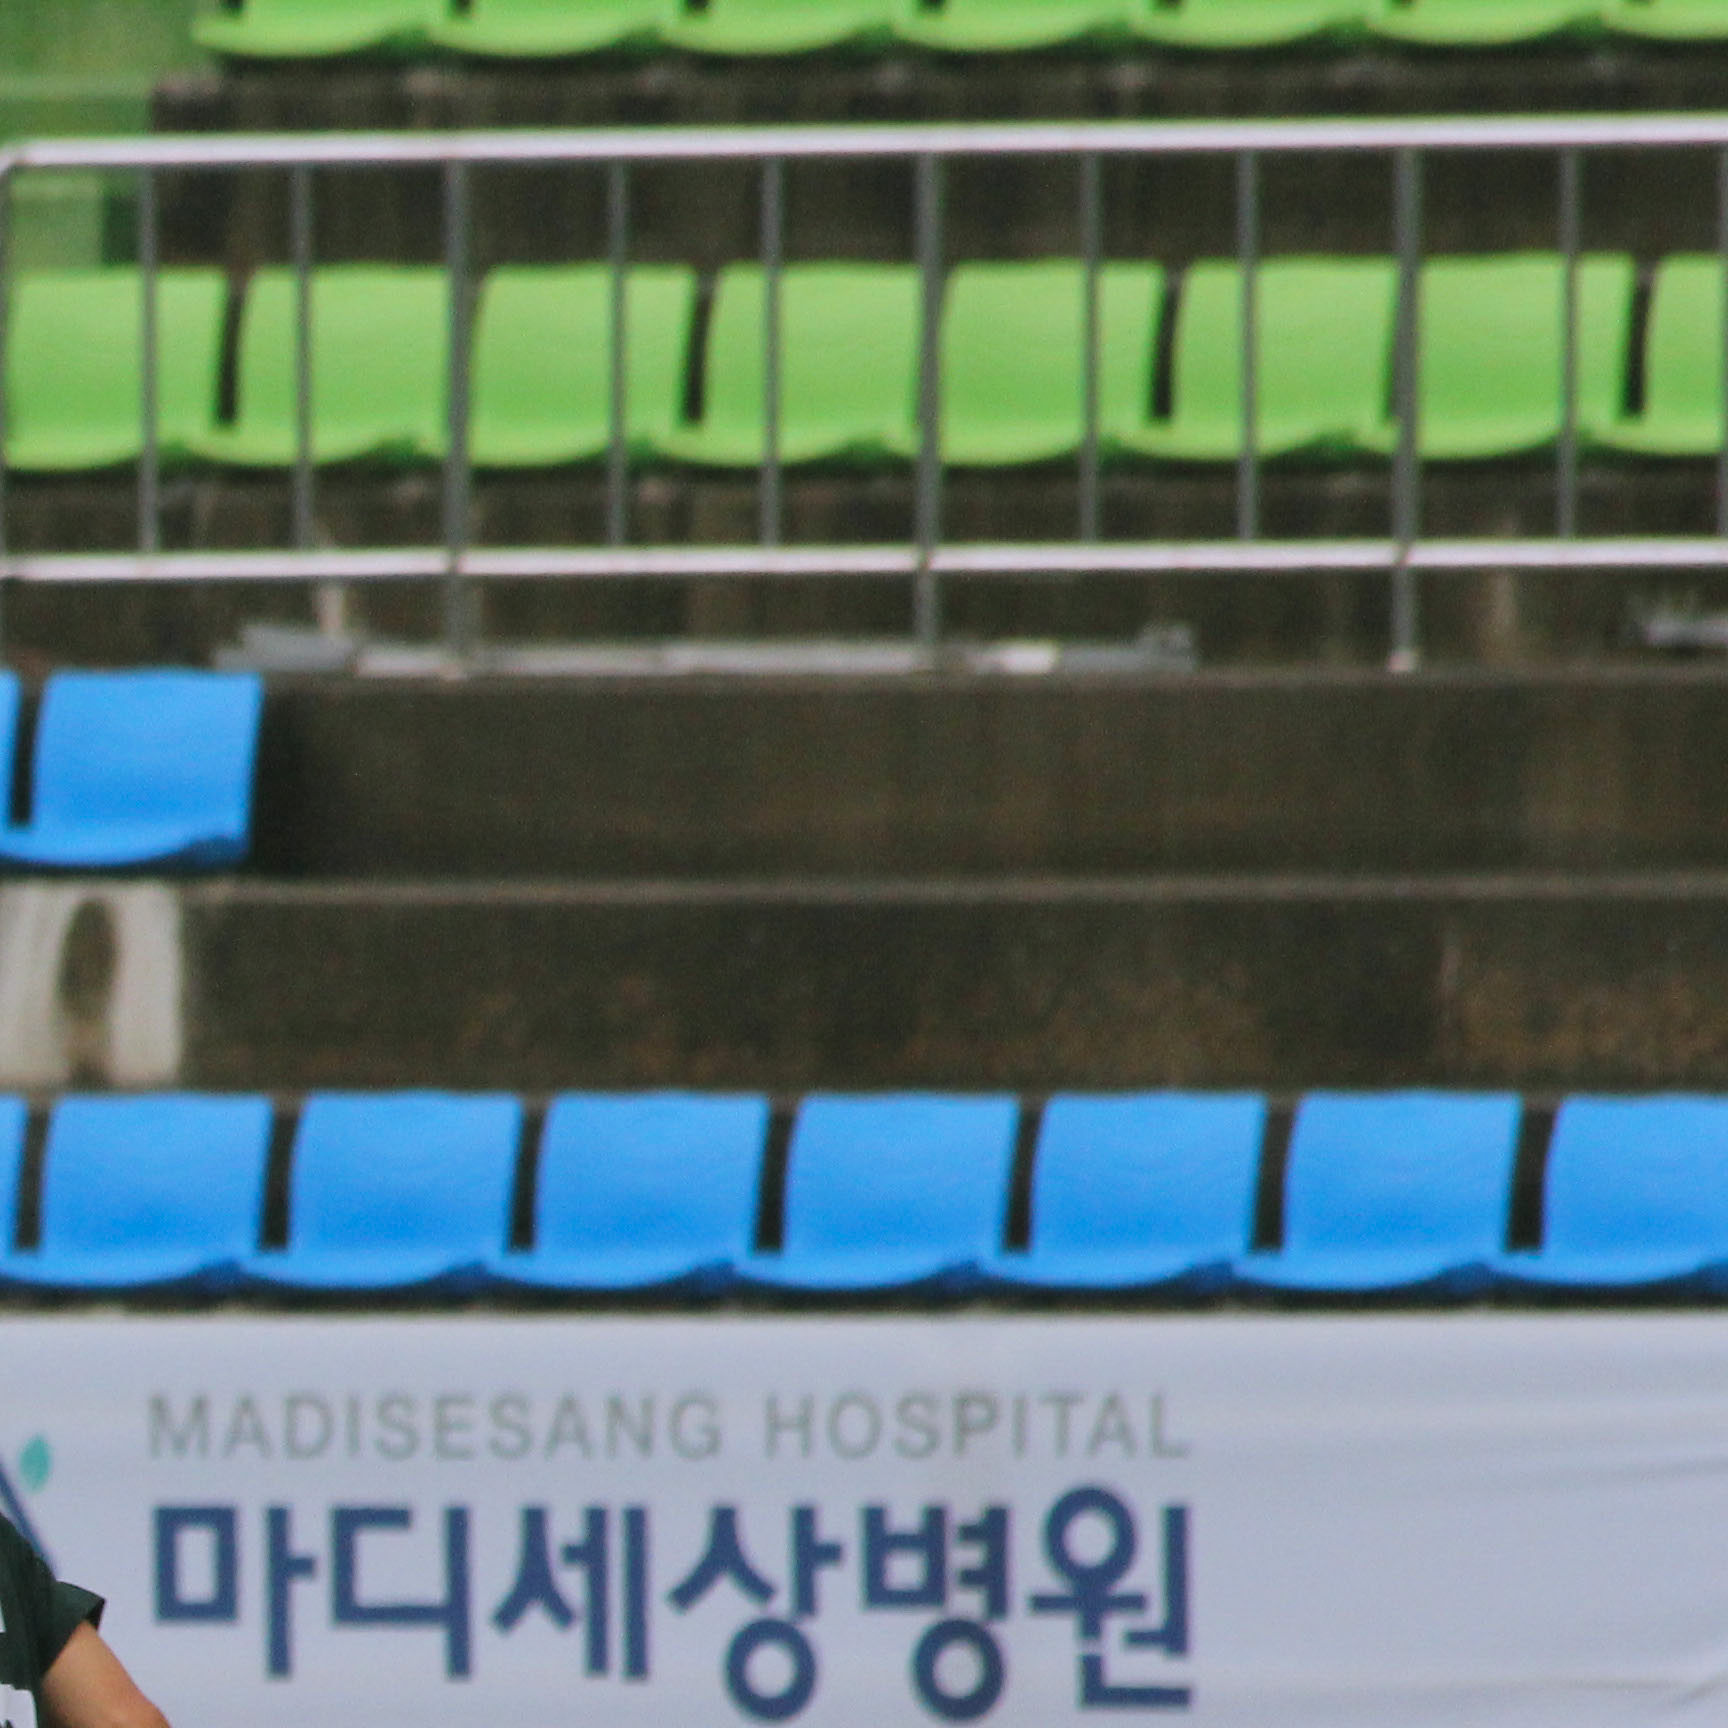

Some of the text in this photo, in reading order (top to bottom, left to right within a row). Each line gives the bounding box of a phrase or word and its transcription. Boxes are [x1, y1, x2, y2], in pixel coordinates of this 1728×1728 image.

[149, 1389, 1191, 1462] MADISESANG HOSPITAL
[151, 1482, 1194, 1724] 마디세상병원
